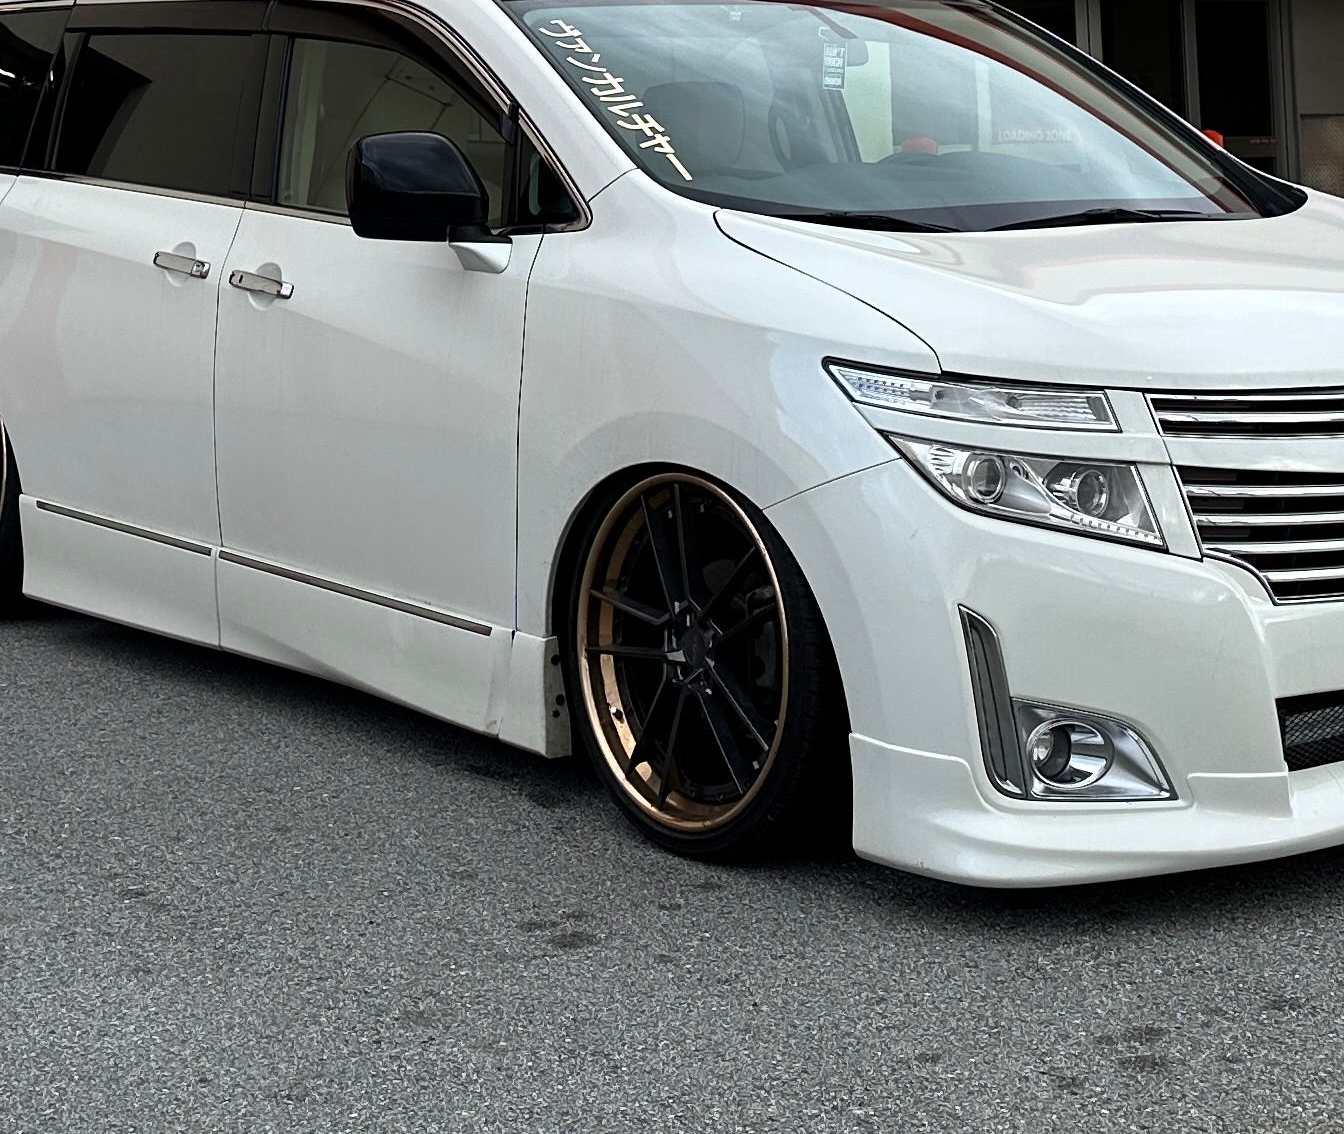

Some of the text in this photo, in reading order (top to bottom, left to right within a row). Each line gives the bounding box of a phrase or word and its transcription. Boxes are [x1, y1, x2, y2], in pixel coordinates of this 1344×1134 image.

[538, 19, 693, 181] ヴァンカルチャー
[998, 129, 1043, 142] LOADING
